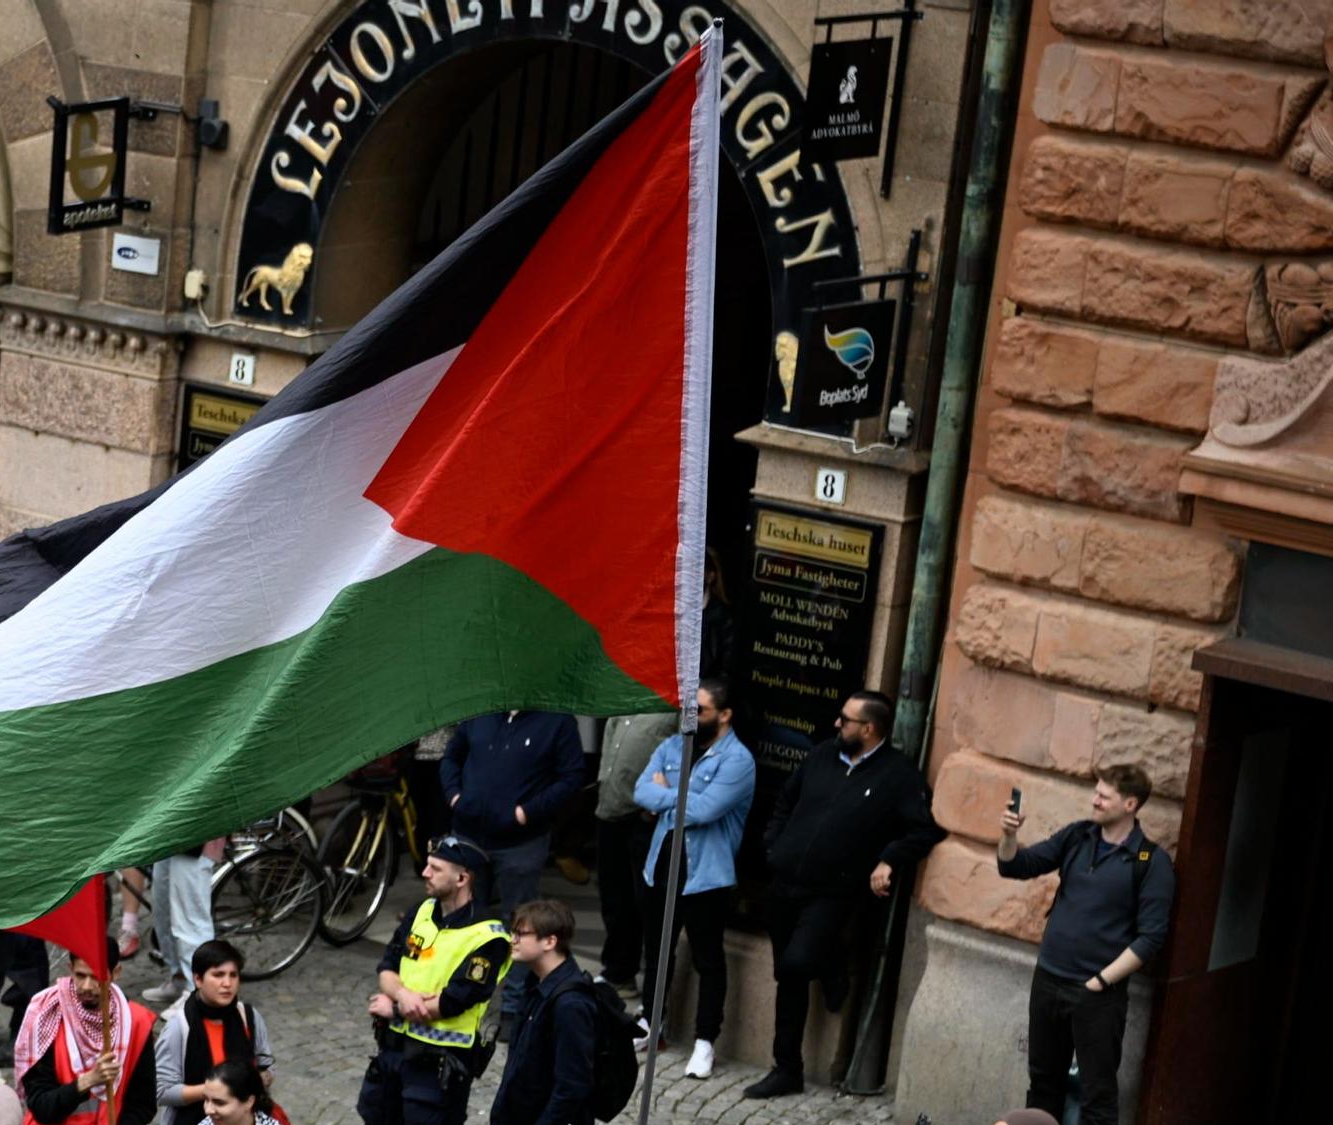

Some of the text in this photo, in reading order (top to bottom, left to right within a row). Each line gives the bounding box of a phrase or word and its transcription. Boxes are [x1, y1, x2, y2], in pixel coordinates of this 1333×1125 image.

[828, 109, 860, 125] MALMÖ
[812, 120, 874, 140] ADVOKATBYRÅ
[235, 359, 245, 381] 8
[819, 384, 869, 408] Boplats Syd
[823, 474, 835, 498] 8
[765, 519, 866, 556] Teschska huset
[759, 558, 861, 591] Jyma Fastigheter
[759, 591, 850, 620] MOLL WENDÉN
[771, 607, 834, 632] Advokatbyrå
[753, 641, 843, 671] Restaurang & Pub
[751, 670, 785, 688] People
[786, 677, 821, 697] Impact
